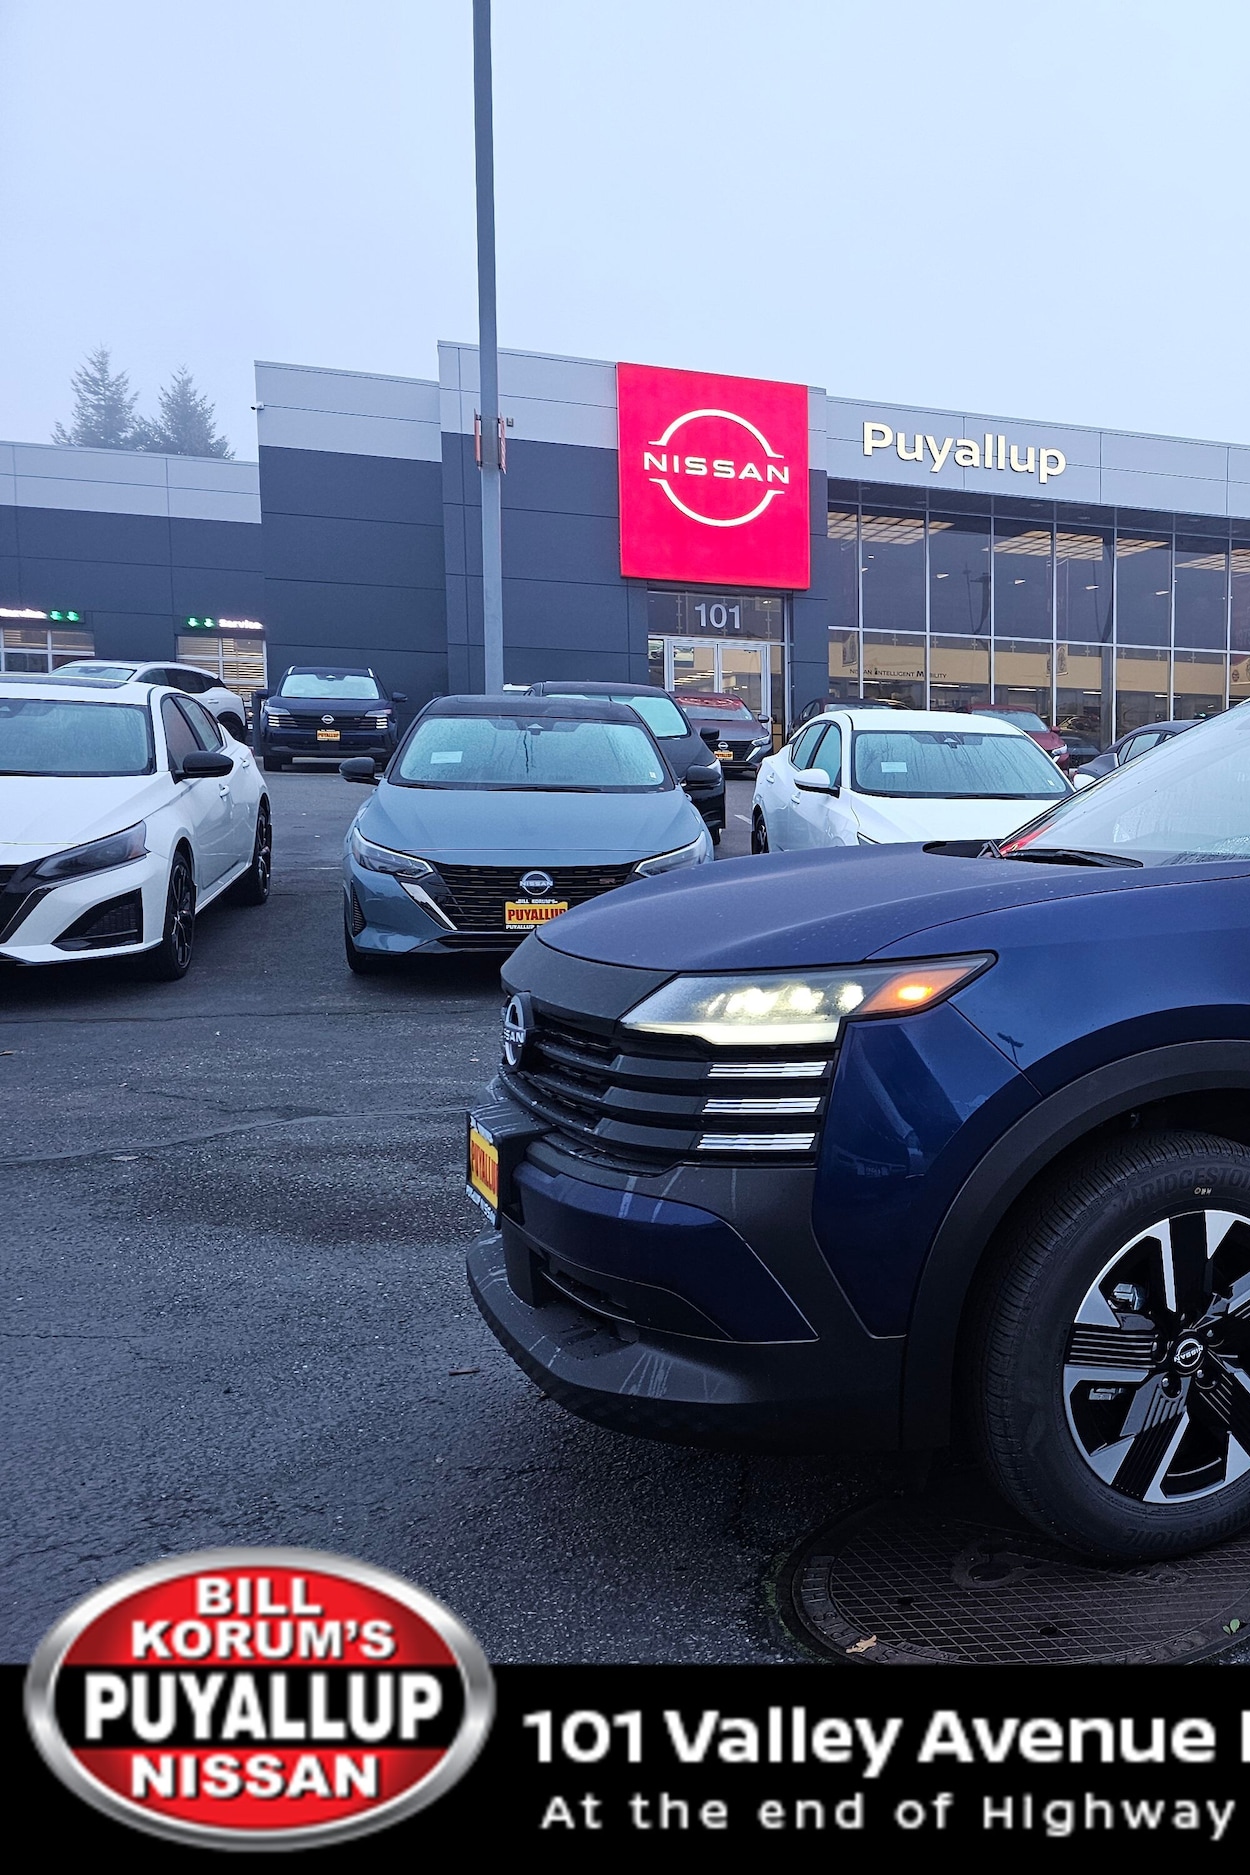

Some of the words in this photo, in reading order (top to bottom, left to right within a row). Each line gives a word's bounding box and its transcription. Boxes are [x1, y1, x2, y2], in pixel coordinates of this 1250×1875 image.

[644, 452, 789, 484] NISSAN
[863, 421, 1067, 484] Puyallup
[694, 603, 740, 629] 101
[471, 1140, 498, 1195] PUYALLU
